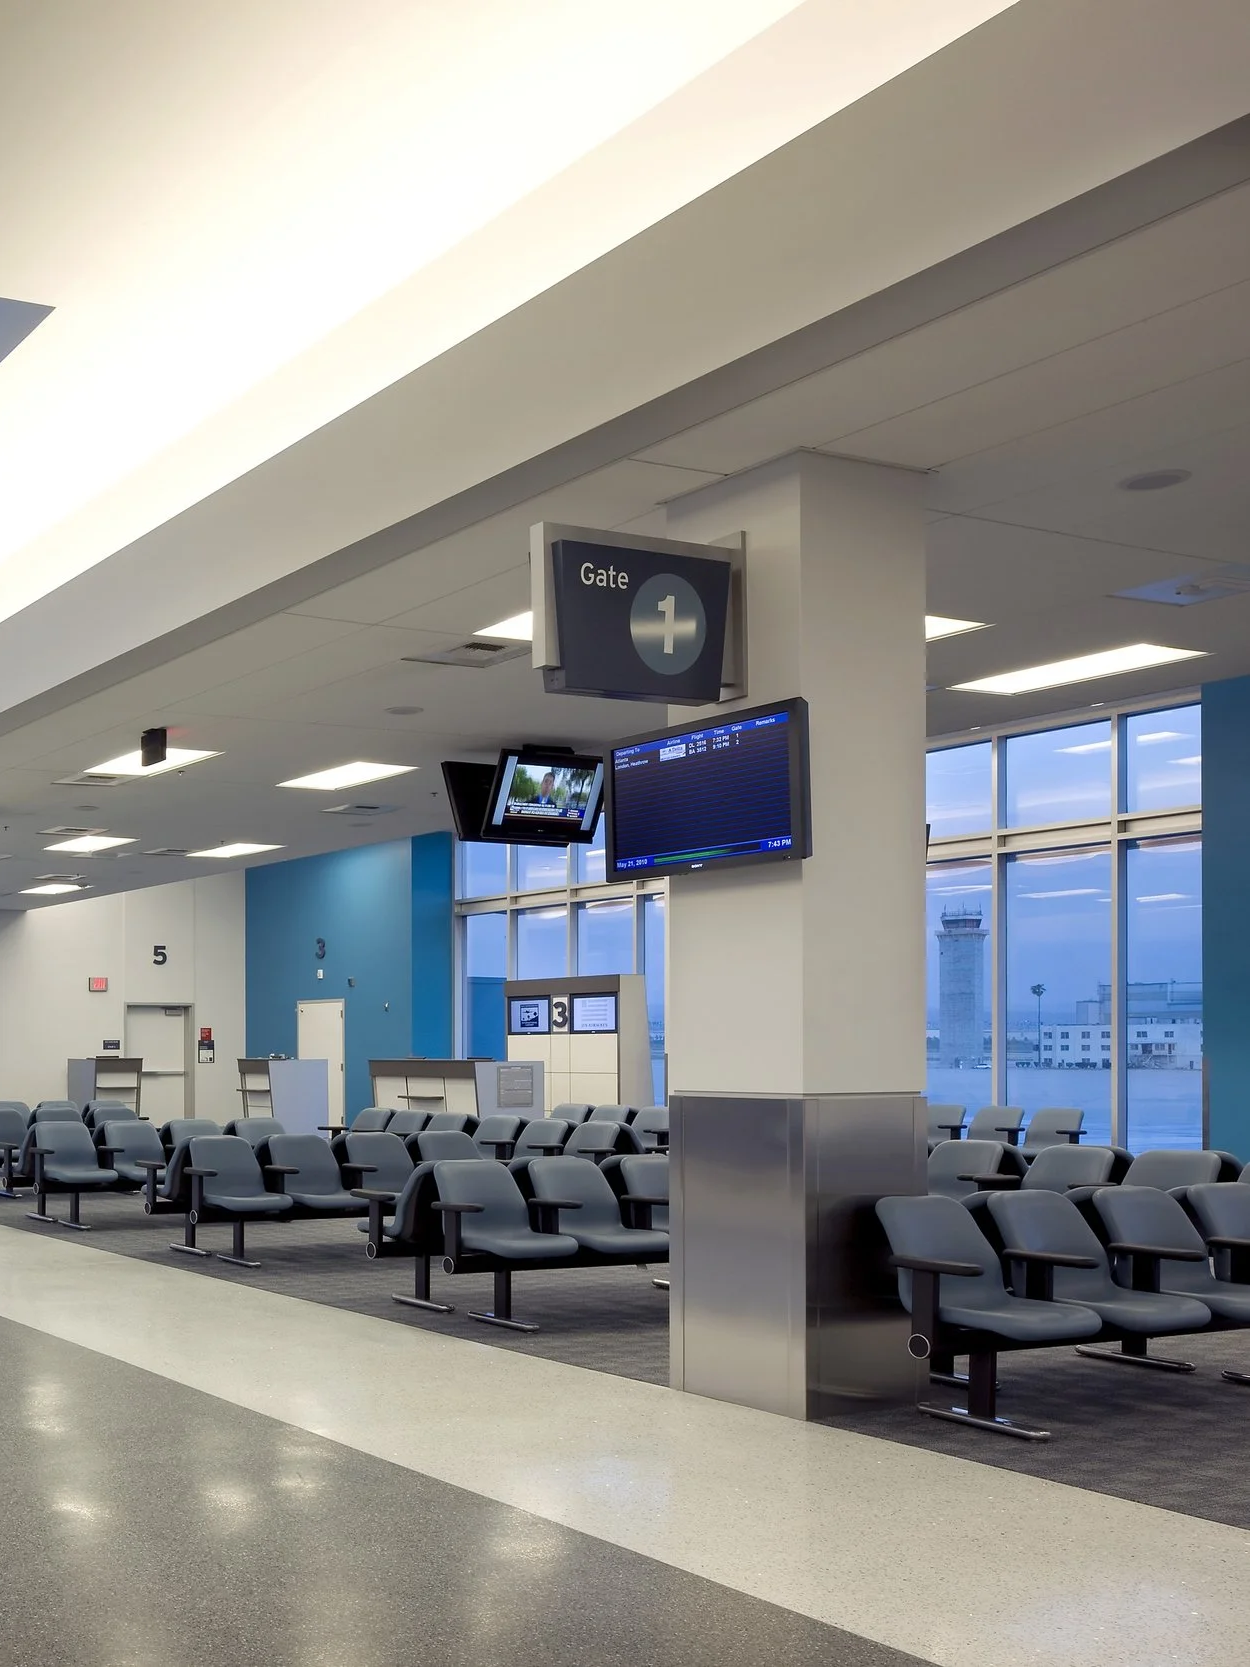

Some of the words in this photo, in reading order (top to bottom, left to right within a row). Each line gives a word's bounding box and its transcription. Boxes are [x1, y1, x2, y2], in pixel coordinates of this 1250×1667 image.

[580, 562, 629, 590] Gate
[657, 595, 675, 655] 1
[691, 733, 704, 741] Flight
[755, 718, 775, 726] Remarks
[781, 838, 792, 846] PM
[617, 861, 627, 869] May
[152, 945, 168, 965] 5
[315, 938, 326, 960] 3
[552, 1001, 568, 1028] 3
